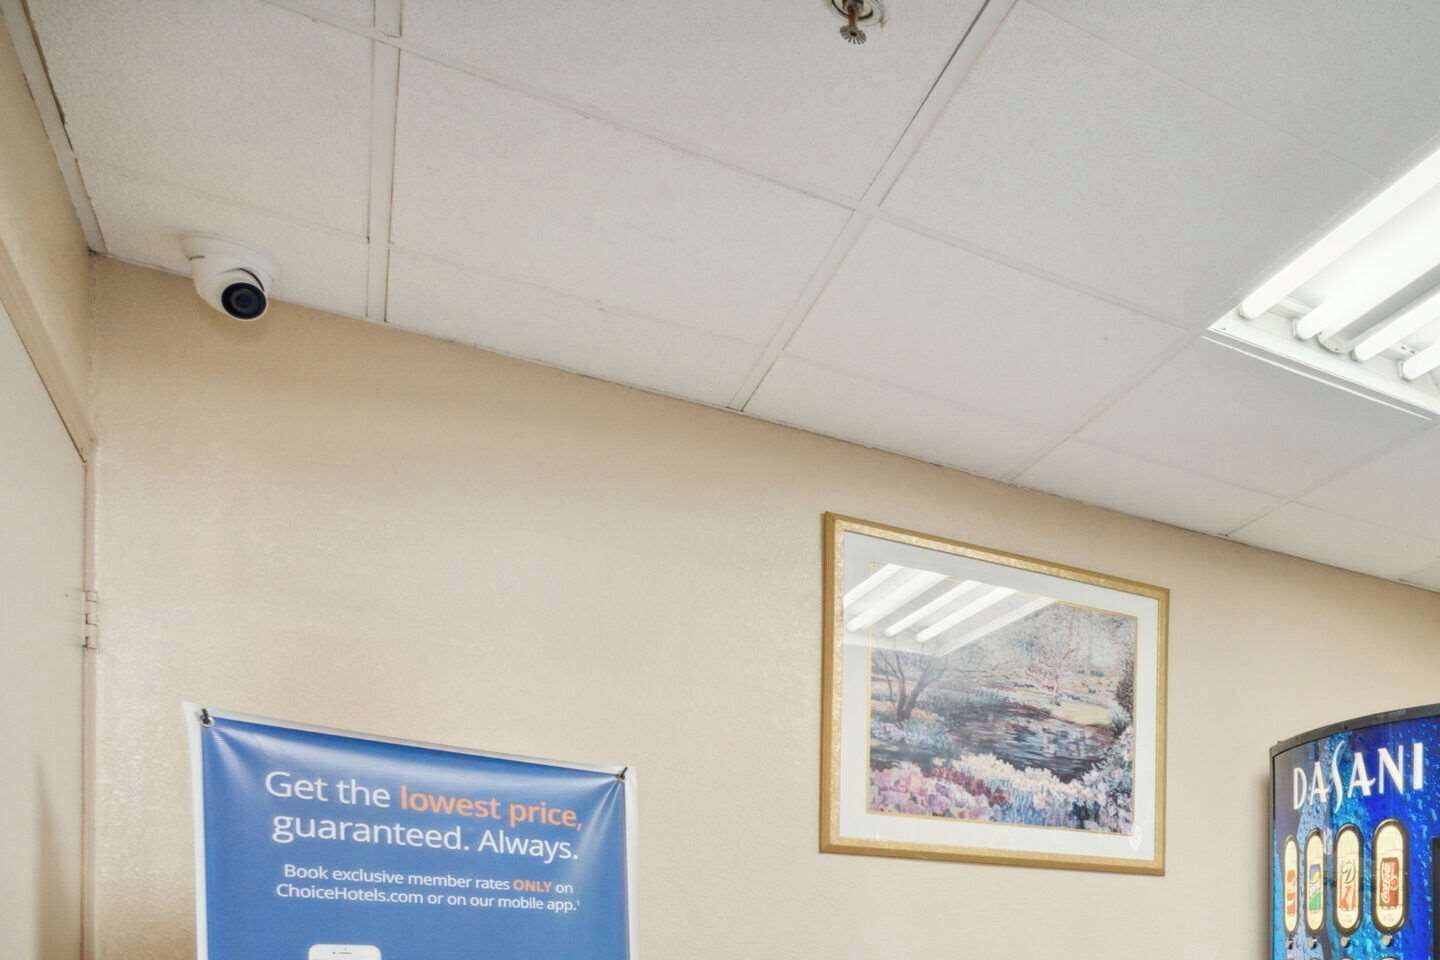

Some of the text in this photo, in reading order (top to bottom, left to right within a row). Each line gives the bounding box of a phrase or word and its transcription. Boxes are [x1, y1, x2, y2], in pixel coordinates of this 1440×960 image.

[265, 771, 583, 831] Get the lowest price,
[1293, 741, 1424, 813] DASANI
[272, 814, 579, 864] guaranteed. Always.
[276, 882, 423, 905] ChoiceHotels.com
[427, 894, 444, 905] or
[447, 894, 467, 906] on
[470, 895, 495, 907] our
[498, 895, 544, 911] mobile
[284, 864, 574, 894] Book exclusive member rates ONLY on
